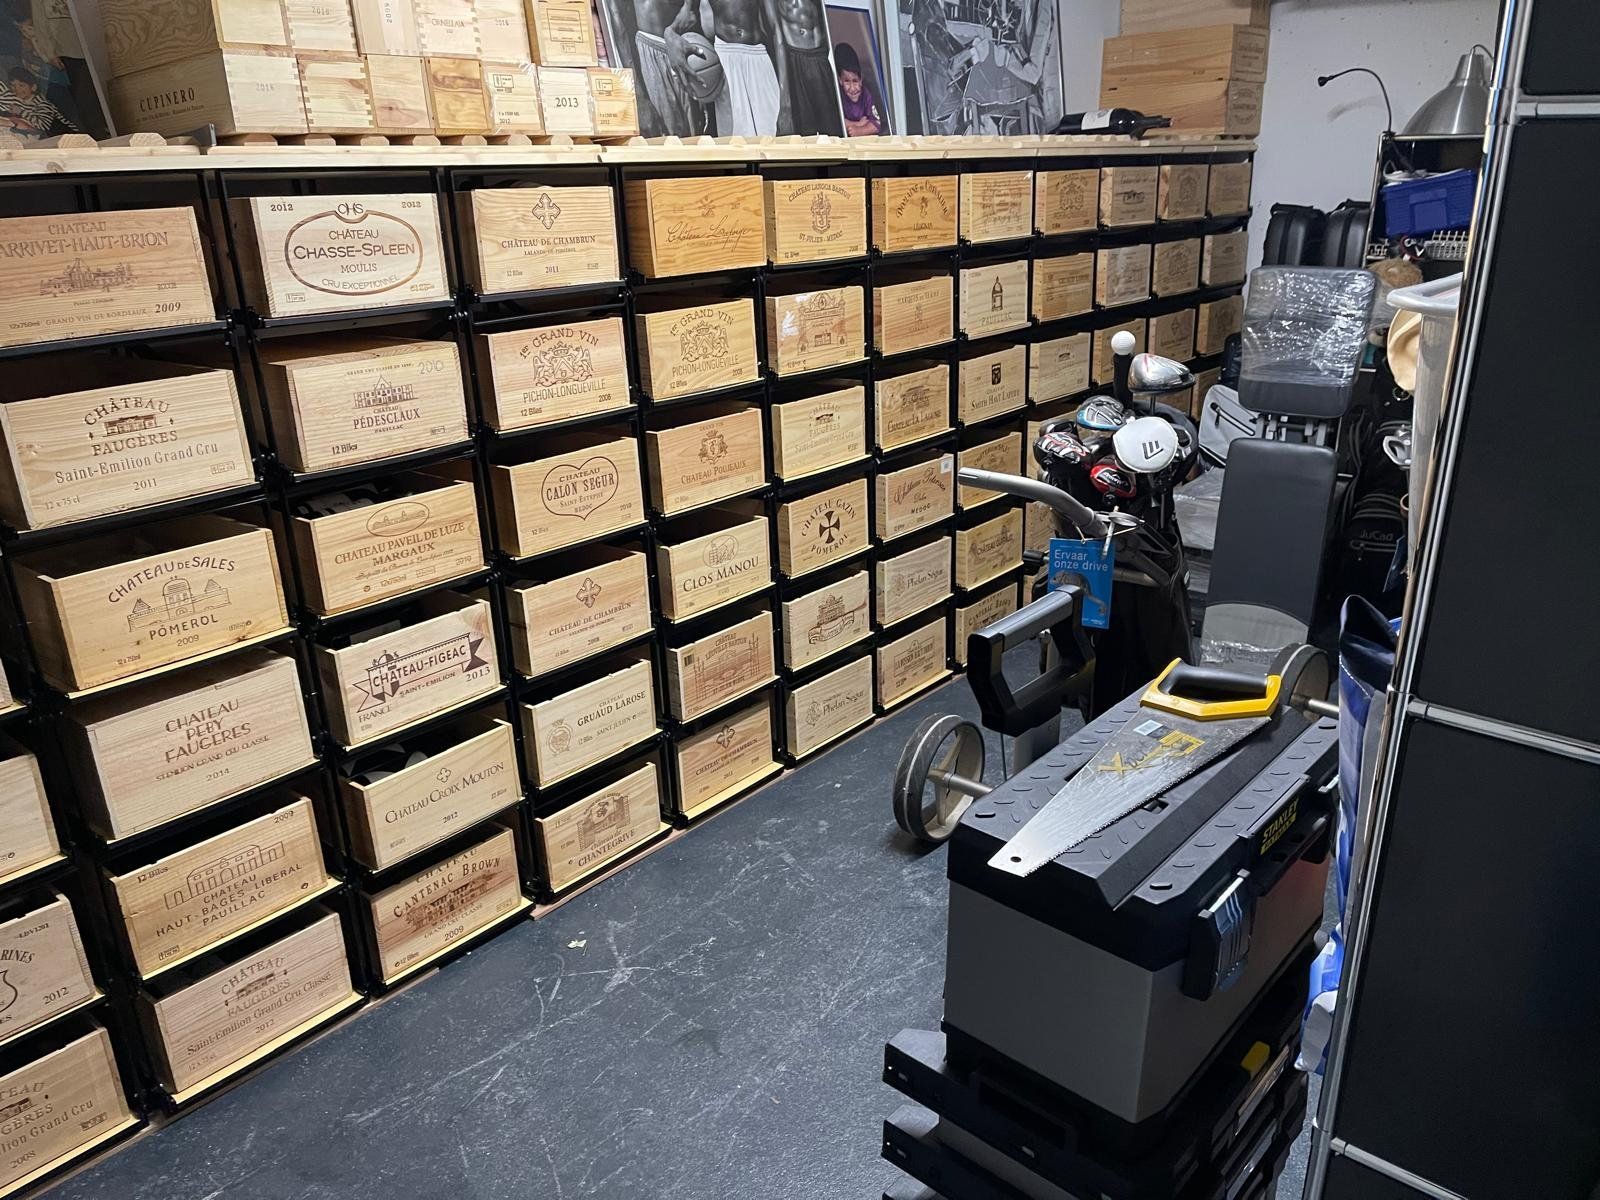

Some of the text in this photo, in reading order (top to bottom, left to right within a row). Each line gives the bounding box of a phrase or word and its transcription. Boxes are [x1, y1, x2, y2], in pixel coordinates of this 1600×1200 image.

[555, 97, 579, 108] 2013
[270, 204, 294, 212] 2012
[48, 221, 107, 235] CHATEAU
[328, 228, 380, 240] CHÂTEAU
[293, 242, 415, 260] CHASSE-SPLEEN
[501, 238, 539, 249] CHÂTEAU
[553, 235, 597, 246] CHAMBRUN
[340, 263, 378, 274] MOULIS
[545, 265, 560, 273] 2011
[322, 275, 400, 290] CRU EXCEPTIONNEL
[155, 302, 181, 313] 2009
[680, 309, 734, 326] GRAND VIN
[45, 316, 75, 326] GRAND
[77, 314, 92, 322] VIN
[532, 328, 574, 348] GRAND
[579, 330, 599, 347] VIN
[523, 378, 606, 404] PICHON-LONGUEVILLE
[84, 396, 170, 426] CHÂTEAU
[352, 407, 421, 430] PÉDESCLAUX
[373, 405, 399, 414] CHÂTEAU
[91, 430, 179, 457] FAUGÈRES
[331, 446, 340, 455] 12
[55, 441, 219, 484] Saint-Emilion Grand Cru
[681, 460, 747, 485] CHATEAU POUJEAUX
[133, 479, 158, 491] 2011
[559, 467, 601, 483] CHATEAU
[546, 473, 615, 502] CALON SEGUR
[836, 498, 857, 519] GAZIN
[334, 541, 386, 565] CHATEAU
[389, 535, 423, 553] PAVEIL
[425, 529, 438, 541] DE
[439, 522, 466, 538] LUZE
[372, 542, 435, 567] MARGAUX
[1054, 549, 1088, 560] Ervaar
[683, 556, 759, 592] CLOS MANOU
[1054, 560, 1108, 572] onze drive
[108, 556, 236, 603] CHATEAU DE SALES
[583, 615, 593, 624] DE
[594, 601, 632, 620] CHAMBRUN
[149, 613, 219, 640] POMEROL
[176, 634, 200, 647] 2009
[373, 645, 467, 687] CHATEAU-FIGEAC
[466, 668, 491, 682] 2013
[400, 672, 456, 698] SAINT-EMILION
[577, 690, 646, 727] GRUAUD LAROSE
[598, 693, 624, 708] CHATEAU
[165, 698, 240, 733] CHATEAU
[358, 704, 392, 723] FRANCE
[186, 717, 224, 741] PEBY
[164, 721, 251, 764] FAUGERES
[206, 767, 230, 781] 2014
[385, 762, 504, 824] CHATEAU CROIX MOUTON
[273, 811, 294, 824] 2009
[443, 811, 458, 824] 2012
[578, 829, 635, 867] CHANTEGRIVE
[137, 874, 146, 883] 12
[254, 863, 303, 890] LIBERAL
[203, 874, 257, 904] CHATEAU
[393, 856, 501, 918] CANTENAC BROWN
[202, 890, 266, 926] PAUILLAC
[444, 925, 464, 942] 2009
[221, 956, 285, 995] CHÂTEAU
[43, 986, 69, 1005] 2012
[187, 1017, 251, 1056] Saint-Emilion
[253, 999, 284, 1019] Grand
[284, 989, 302, 1004] Cru
[30, 1111, 69, 1138] Grand
[72, 1100, 94, 1116] Cru
[9, 1150, 36, 1169] 2008
